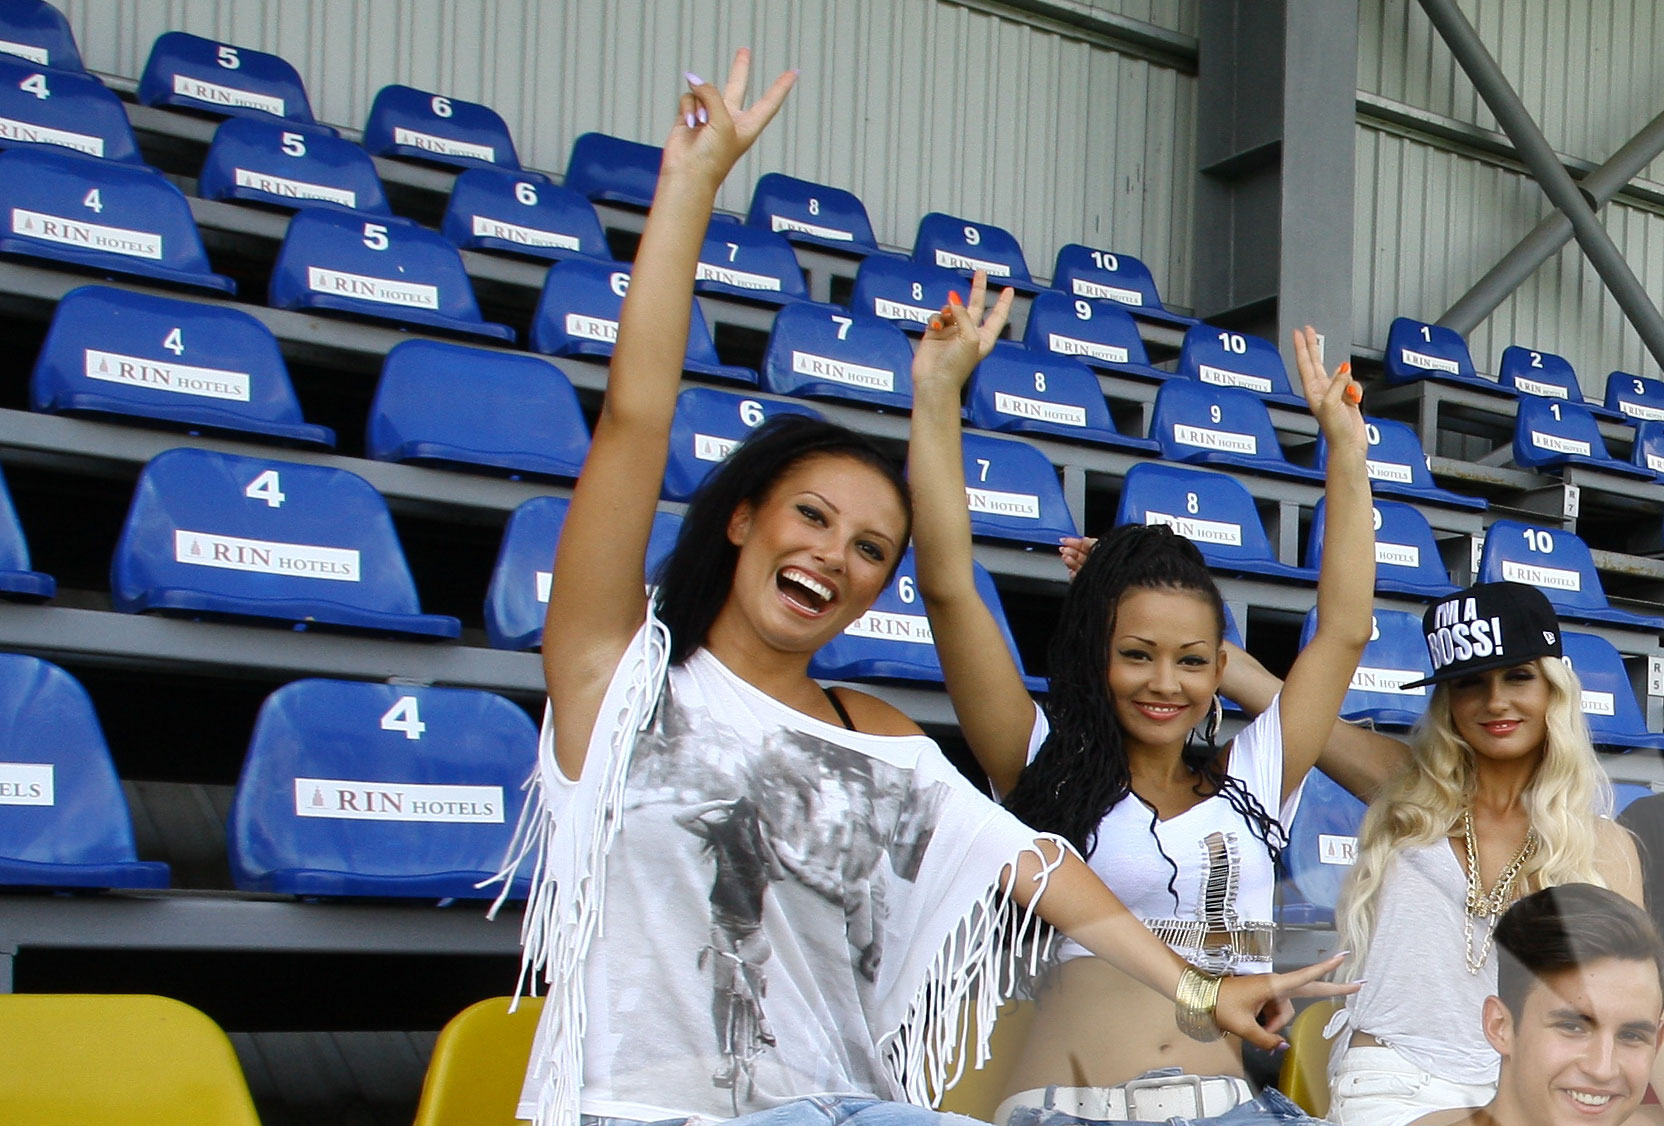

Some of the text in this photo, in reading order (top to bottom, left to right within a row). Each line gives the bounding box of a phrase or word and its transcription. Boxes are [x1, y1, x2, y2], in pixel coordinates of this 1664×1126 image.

[217, 46, 240, 69] 5
[20, 74, 50, 99] 4
[196, 85, 231, 103] RIN
[432, 97, 452, 118] 6
[281, 132, 306, 157] 5
[415, 136, 445, 153] RIN
[260, 179, 297, 198] RIN
[515, 182, 538, 206] 6
[84, 189, 103, 213] 4
[808, 198, 820, 216] 8
[43, 220, 155, 255] RIN HOTELS
[362, 223, 389, 250] 5
[494, 225, 527, 243] RIN
[963, 226, 981, 246] 9
[726, 243, 740, 262] 7
[1091, 251, 1119, 272] 10
[610, 272, 631, 297] 6
[704, 268, 734, 285] RIN
[334, 276, 433, 305] RIN HOTELS
[911, 282, 924, 301] 8
[1085, 284, 1109, 299] RIN
[1074, 300, 1092, 320] 9
[832, 315, 853, 340] 7
[1420, 326, 1432, 343] 1
[164, 328, 184, 355] 4
[1064, 341, 1090, 356] RIN
[1219, 332, 1247, 355] 10
[1413, 355, 1432, 370] RIN
[1530, 352, 1543, 369] 2
[117, 361, 242, 395] RIN HOTELS
[812, 361, 889, 388] RIN HOTELS
[1034, 372, 1046, 392] 8
[1213, 371, 1237, 386] RIN
[1633, 379, 1646, 395] 3
[739, 400, 765, 426] 6
[1012, 401, 1081, 423] RIN HOTELS
[1209, 405, 1222, 423] 9
[1550, 404, 1561, 422] 1
[1189, 432, 1252, 451] RIN HOTELS
[1543, 436, 1563, 451] RIN
[976, 459, 990, 481] 7
[1378, 469, 1409, 480] HOTELS
[245, 471, 285, 508] 4
[1187, 493, 1199, 514] 8
[1197, 529, 1237, 542] HOTELS
[1523, 528, 1554, 554] 10
[212, 542, 351, 575] RIN HOTELS
[1378, 551, 1415, 563] HOTELS
[1517, 567, 1576, 589] RIN HOTELS
[898, 576, 916, 603] 6
[1463, 598, 1478, 623] A
[869, 616, 911, 636] RIN
[1427, 617, 1504, 670] BOSS!
[380, 696, 426, 740] 4
[335, 788, 494, 817] RIN HOTELS
